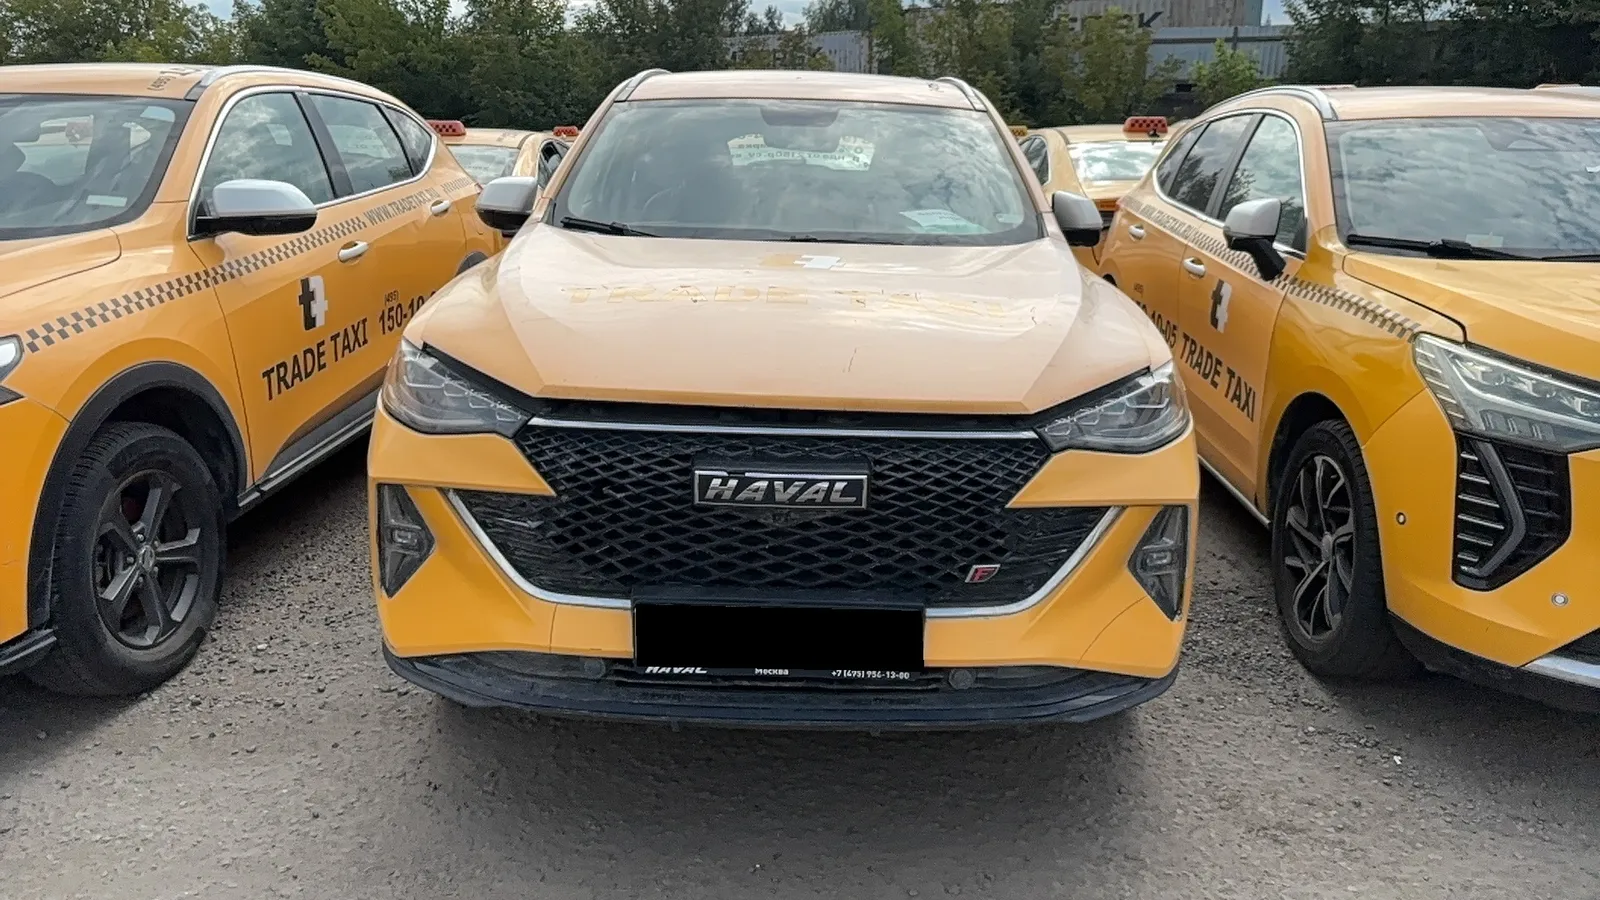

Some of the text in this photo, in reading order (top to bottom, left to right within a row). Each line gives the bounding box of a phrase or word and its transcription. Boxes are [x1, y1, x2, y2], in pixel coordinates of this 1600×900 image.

[363, 187, 440, 226] WWW.TRADETAXI.RU
[262, 340, 326, 401] TRADE
[330, 317, 369, 363] TAXI
[1180, 332, 1223, 389] TRADE
[1223, 366, 1256, 422] TAXI
[704, 477, 857, 504] HAVAL
[755, 667, 789, 676] Москва
